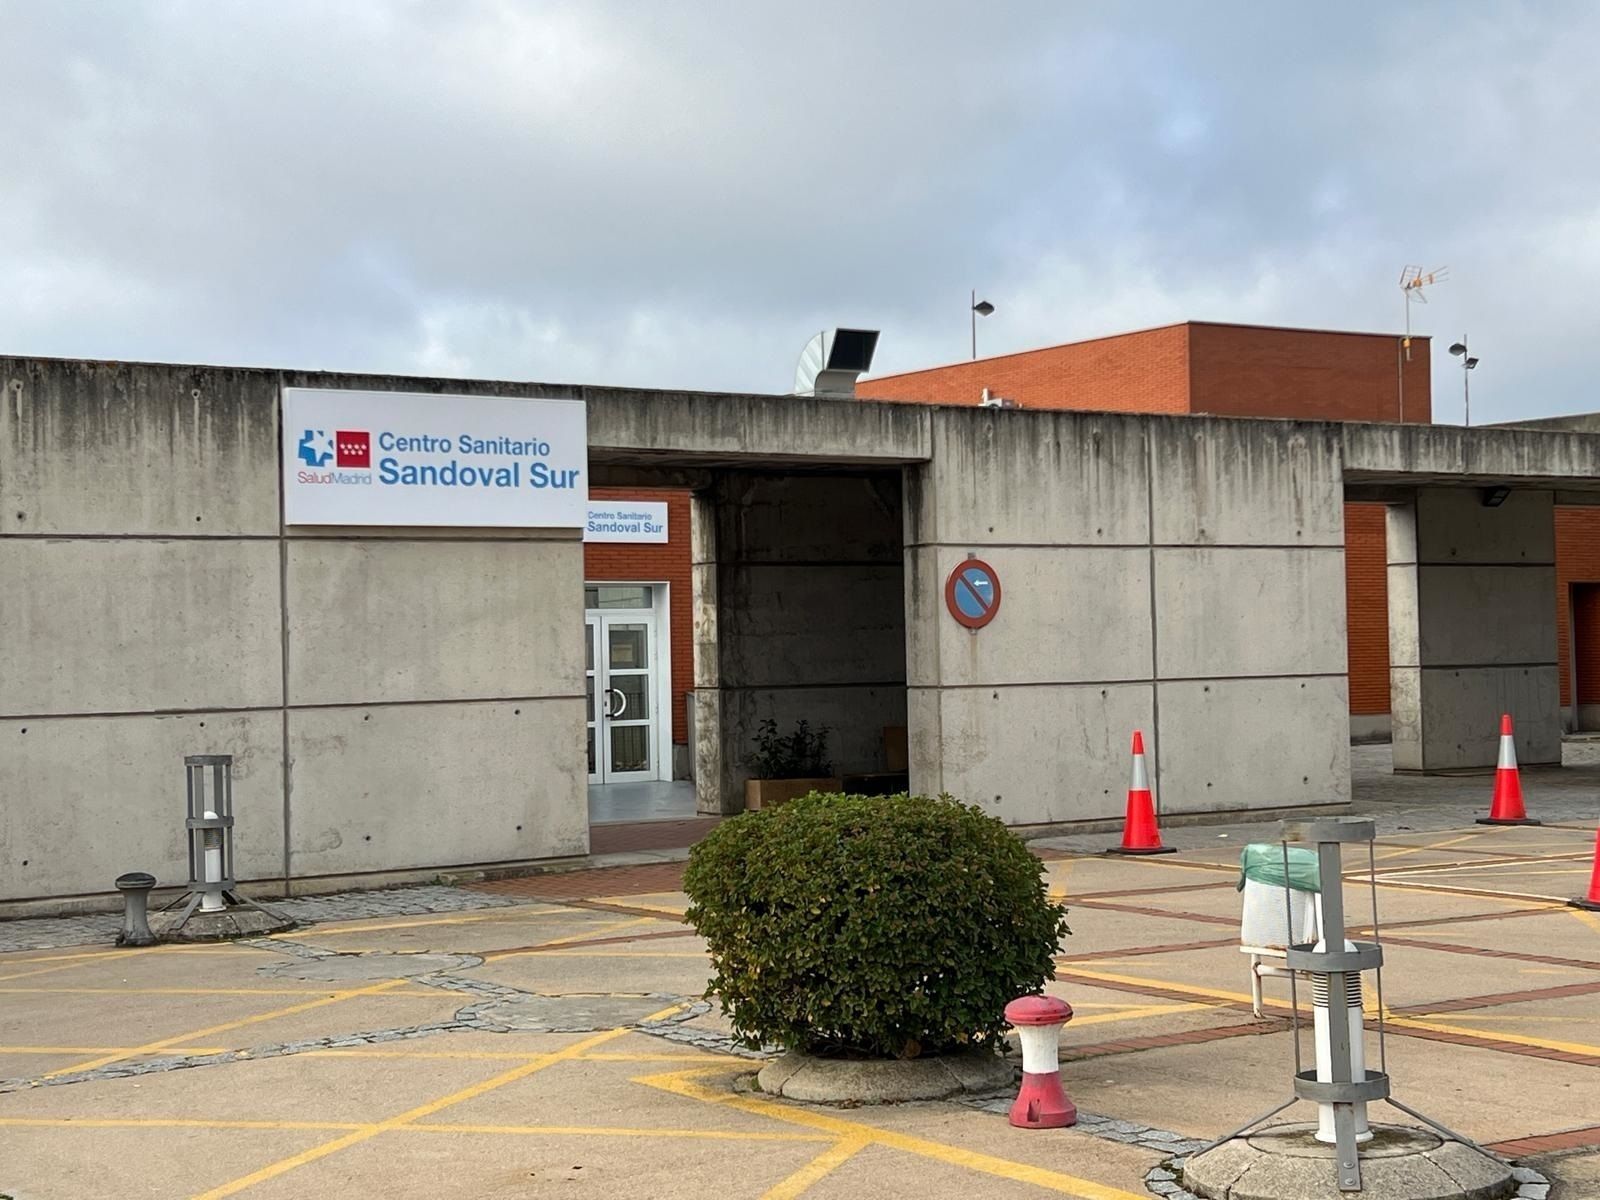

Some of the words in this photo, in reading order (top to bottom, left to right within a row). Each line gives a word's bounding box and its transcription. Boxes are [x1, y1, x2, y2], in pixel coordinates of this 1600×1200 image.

[379, 432, 451, 453] Centro
[458, 435, 551, 456] Sanitario
[297, 471, 372, 485] SaludMadrid
[379, 458, 520, 487] Sandoval
[530, 462, 580, 489] Sur
[587, 511, 615, 520] Centro
[616, 512, 653, 521] Sanitario
[587, 521, 641, 533] Sandoval
[643, 522, 664, 533] Sur
